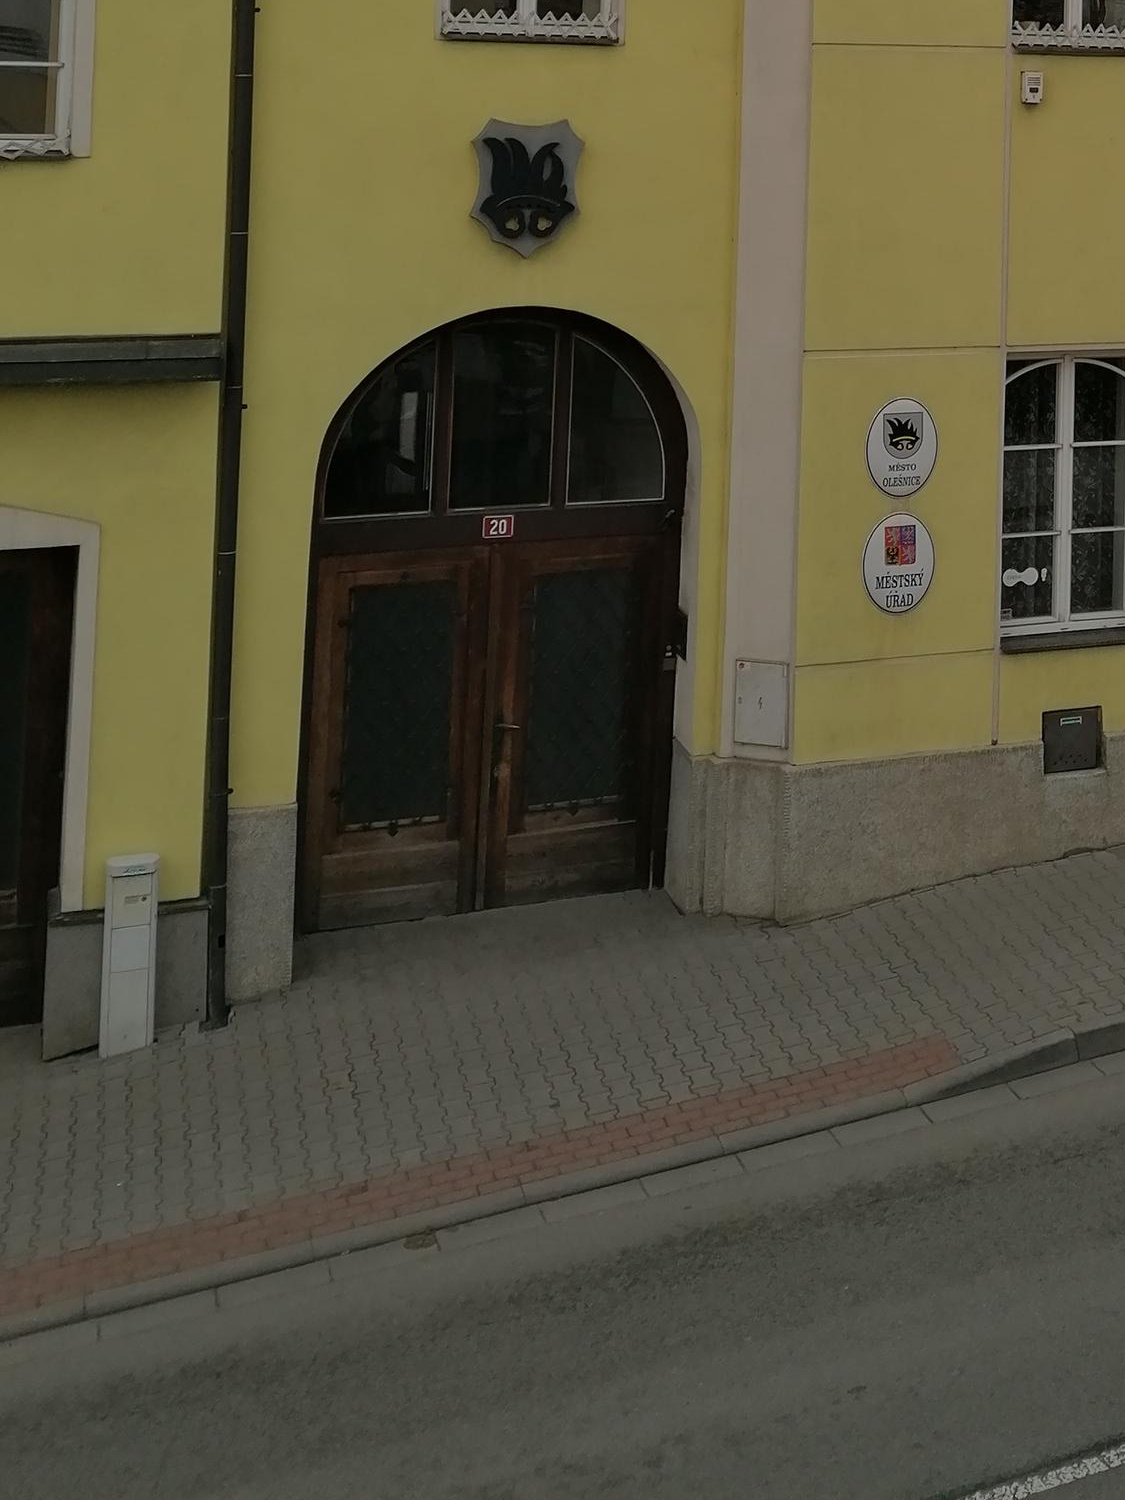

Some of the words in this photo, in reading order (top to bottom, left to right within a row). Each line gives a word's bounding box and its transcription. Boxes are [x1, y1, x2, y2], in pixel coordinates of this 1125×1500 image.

[883, 473, 921, 487] OLEŠNICE
[489, 519, 507, 535] 20
[875, 568, 924, 589] MĚSTSKÝ
[886, 591, 914, 608] ÚŘAD
